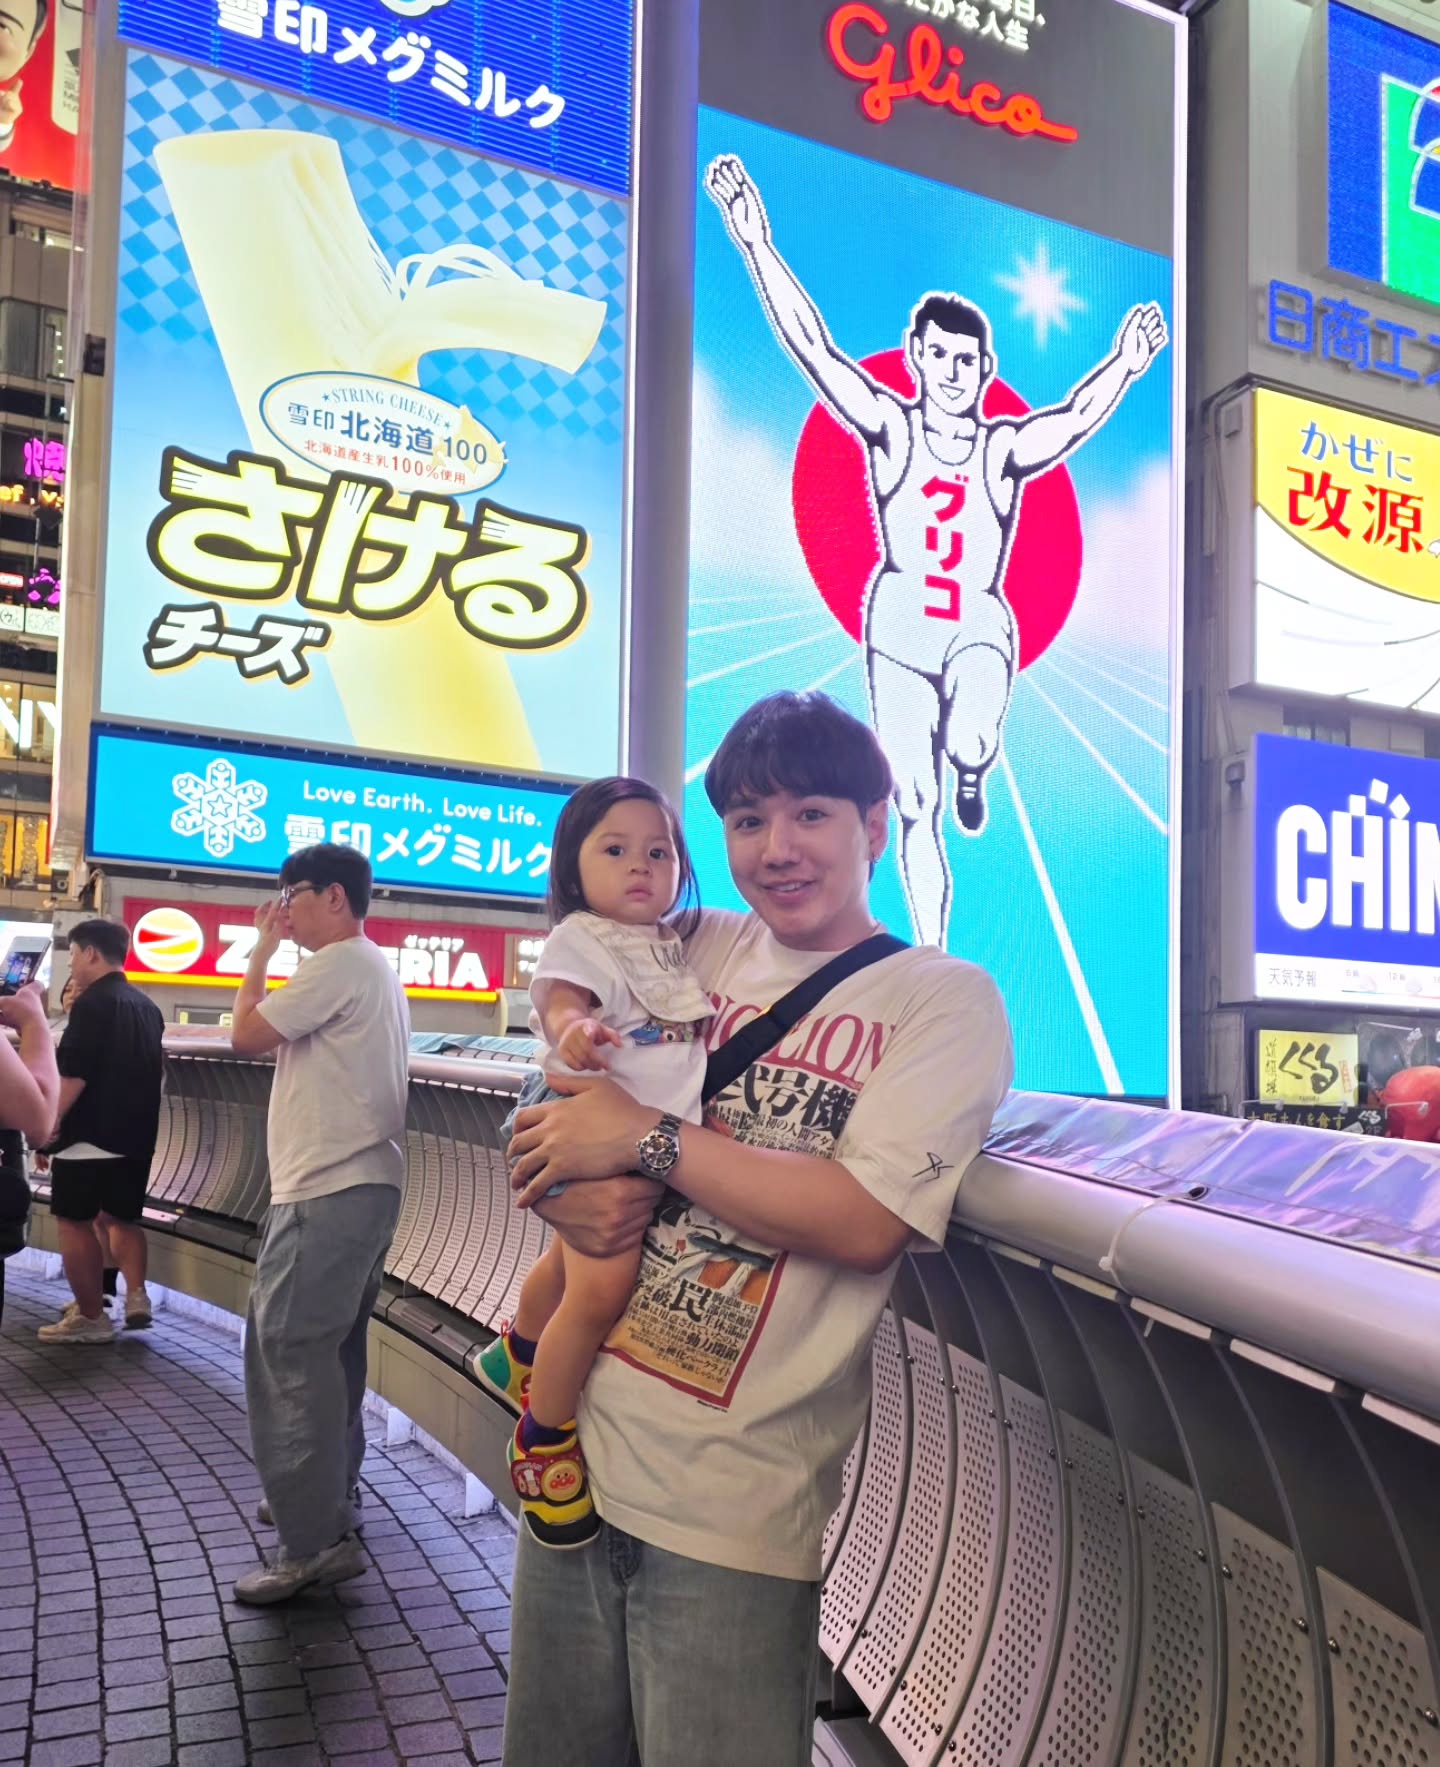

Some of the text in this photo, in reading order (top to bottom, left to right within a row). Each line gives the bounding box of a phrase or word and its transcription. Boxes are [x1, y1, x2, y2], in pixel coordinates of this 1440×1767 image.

[216, 0, 566, 129] 雪印メグミルク
[826, 3, 1079, 143] Glico
[332, 386, 445, 427] STRING CHEESE
[1300, 421, 1413, 483] かぜに
[150, 449, 584, 643] さける
[921, 474, 970, 622] グリコ
[1287, 466, 1424, 553] 改源
[145, 604, 330, 683] チーズ
[303, 780, 542, 827] Love Earth. Love Life.
[1279, 1041, 1339, 1094] くくる
